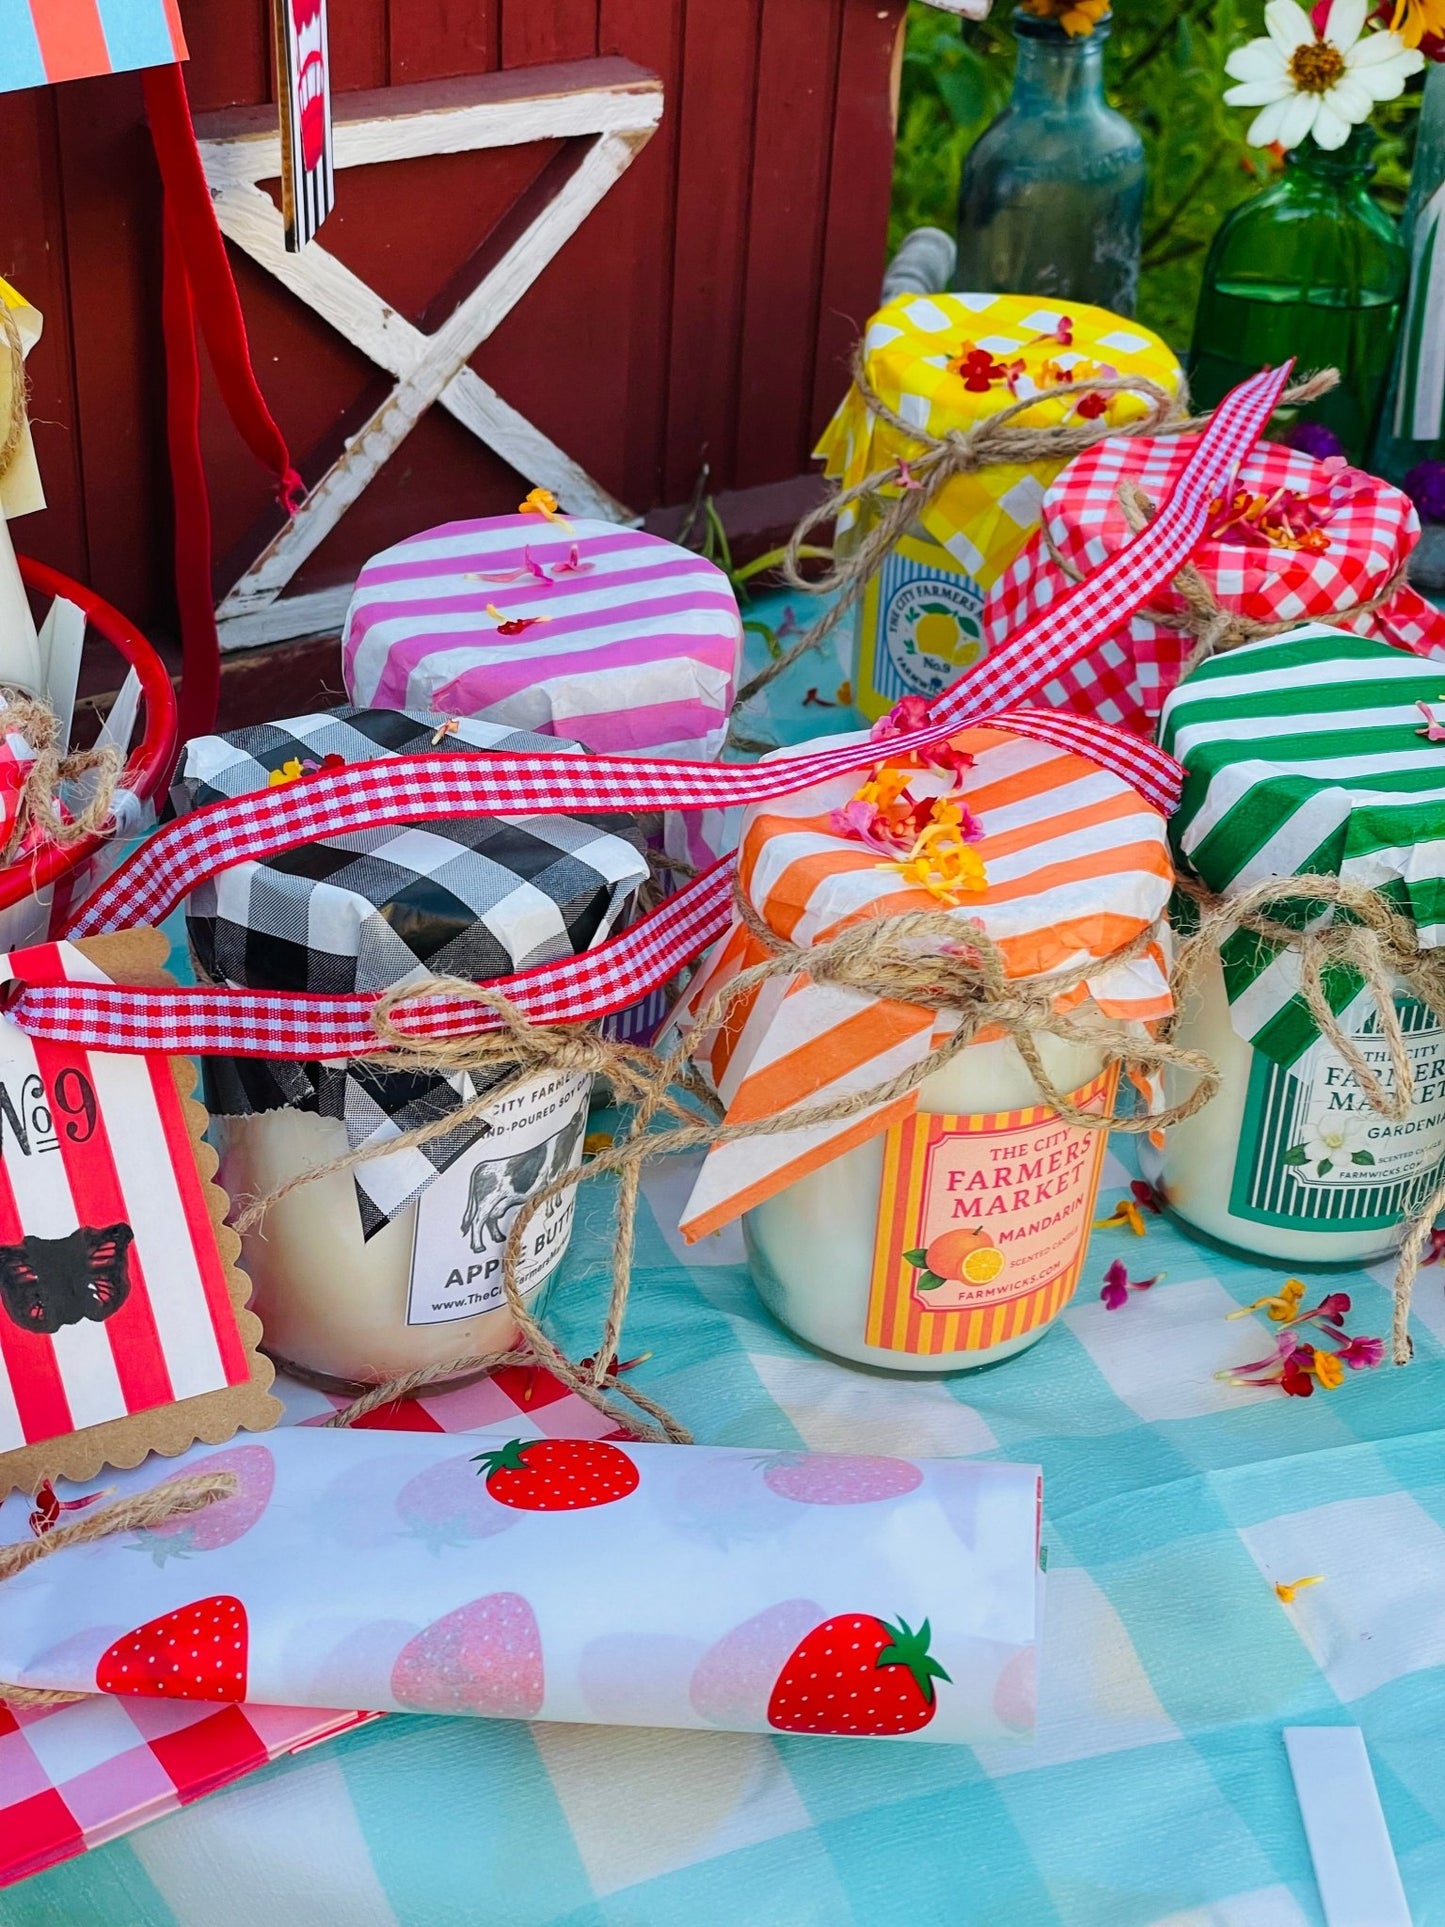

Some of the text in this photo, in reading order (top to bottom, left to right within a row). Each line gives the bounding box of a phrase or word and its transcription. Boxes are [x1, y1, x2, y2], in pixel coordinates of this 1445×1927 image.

[916, 585, 978, 612] FARMERS
[1364, 1051, 1391, 1062] TH
[54, 1067, 97, 1143] 9
[559, 1089, 575, 1107] SOY
[946, 1131, 1093, 1192] FARMERS
[990, 1127, 1073, 1162] THE CITY
[1340, 1160, 1424, 1180] FARMWICKSCOM
[951, 1161, 1085, 1219] MARKET
[534, 1200, 575, 1256] BUTT
[999, 1193, 1084, 1244] MANDARIN
[1010, 1246, 1050, 1268] SCENTED
[958, 1260, 1062, 1301] FARMWICKS.COM
